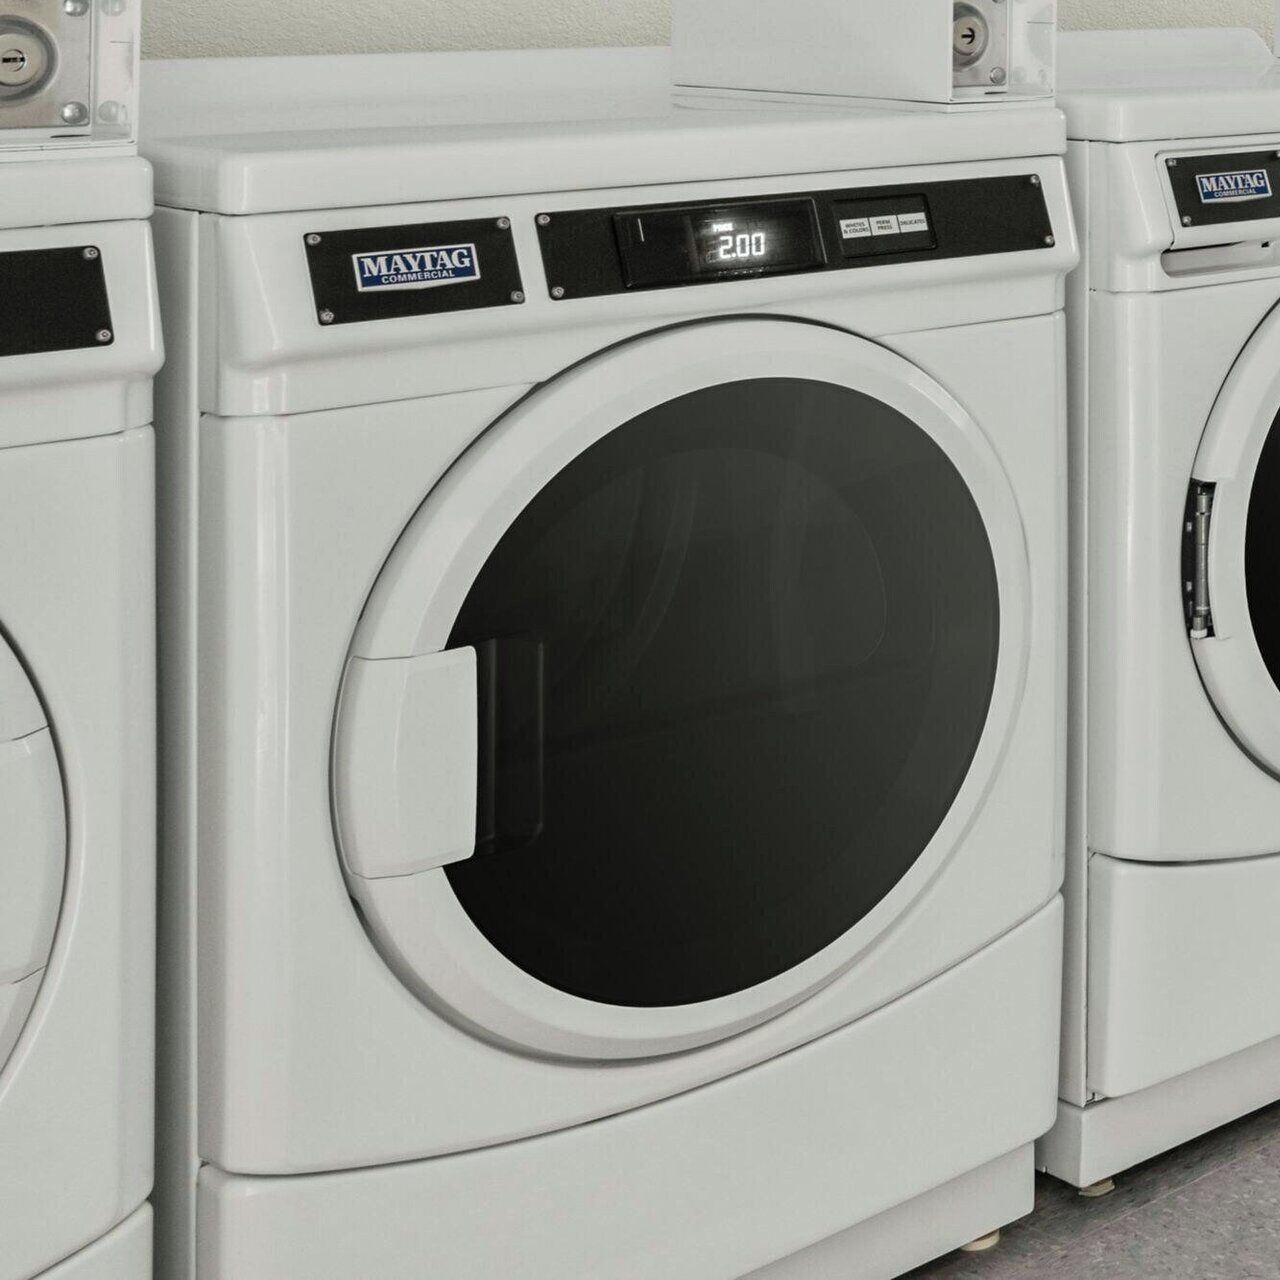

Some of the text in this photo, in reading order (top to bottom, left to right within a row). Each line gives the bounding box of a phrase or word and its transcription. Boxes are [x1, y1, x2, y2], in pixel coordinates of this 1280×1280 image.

[1200, 173, 1266, 193] MAYTAG
[1214, 188, 1257, 198] COMMERCIAL
[900, 218, 926, 226] DELICATES
[849, 226, 869, 234] COLORS
[719, 232, 766, 259] 2.00
[360, 249, 471, 278] MAYTAG
[381, 269, 456, 284] COMMERCIAL
